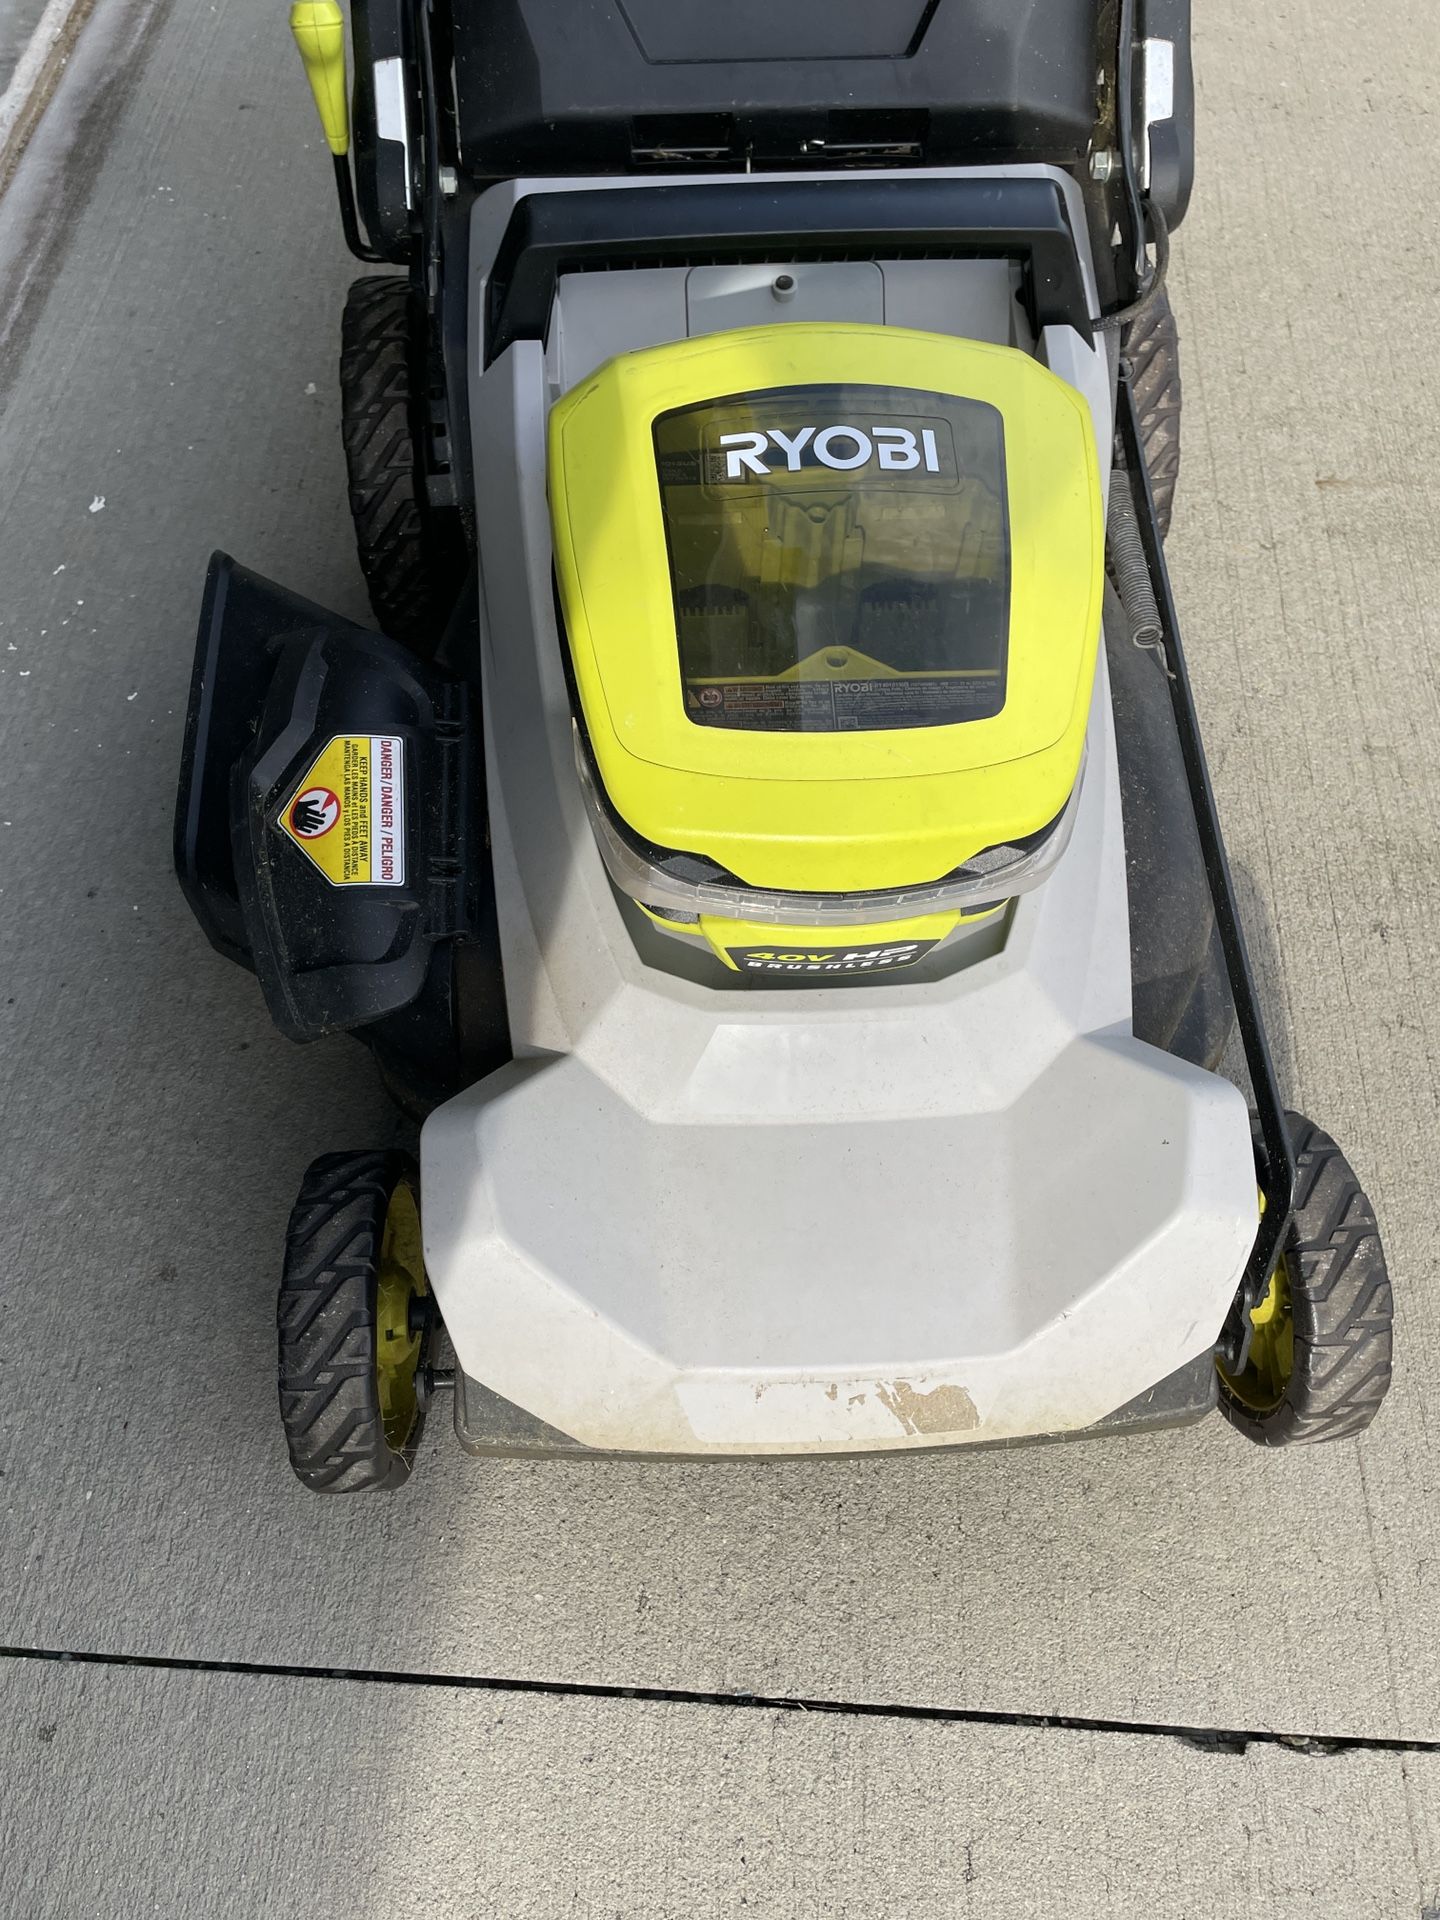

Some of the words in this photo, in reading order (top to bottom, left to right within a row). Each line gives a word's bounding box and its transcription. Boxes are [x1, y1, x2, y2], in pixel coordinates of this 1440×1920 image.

[720, 425, 940, 478] RYOBI
[834, 682, 873, 693] RYOBI
[381, 741, 392, 779] DANGER
[360, 777, 368, 802] HANDS
[381, 787, 392, 827] DANGER
[360, 841, 368, 862] AWAY
[382, 838, 393, 880] PELIGRO
[746, 952, 835, 962] 40V
[747, 954, 912, 970] BRUSHLESS
